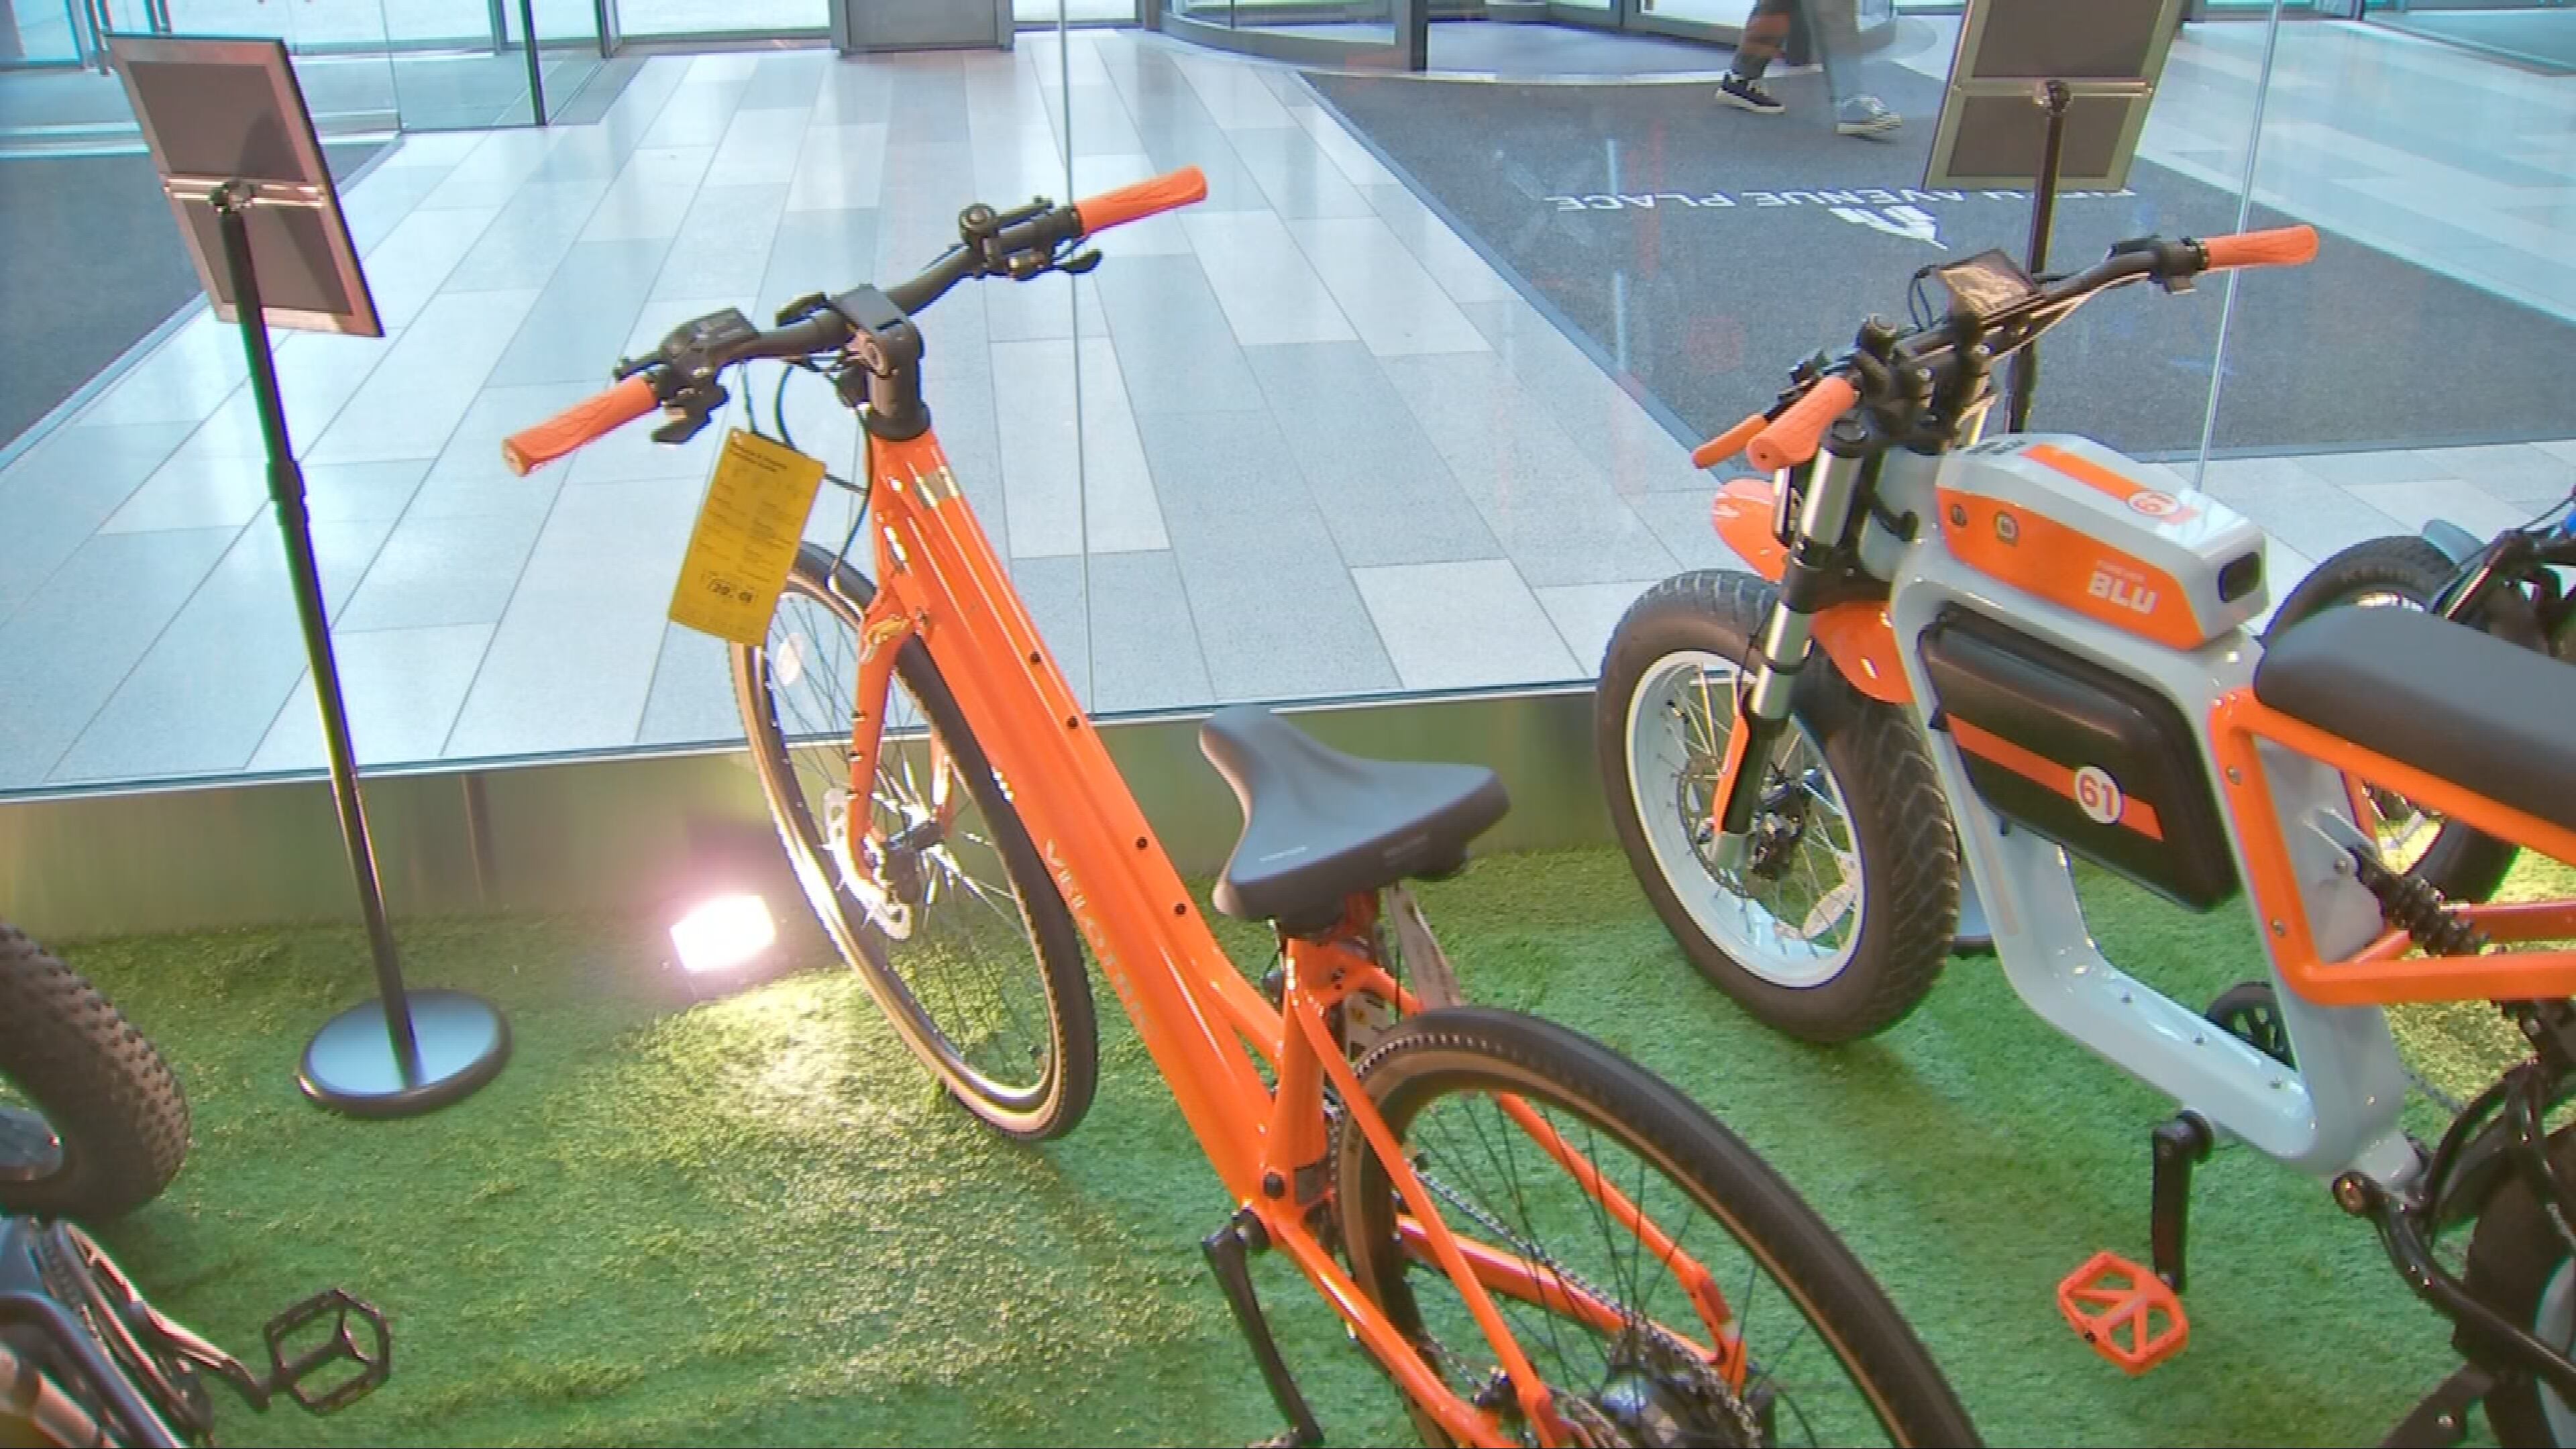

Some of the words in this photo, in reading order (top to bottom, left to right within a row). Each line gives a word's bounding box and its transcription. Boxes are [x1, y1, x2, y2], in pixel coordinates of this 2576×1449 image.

[1544, 193, 1736, 211] PLACE
[1741, 189, 1966, 207] AVENUE
[2080, 773, 2115, 816] 61
